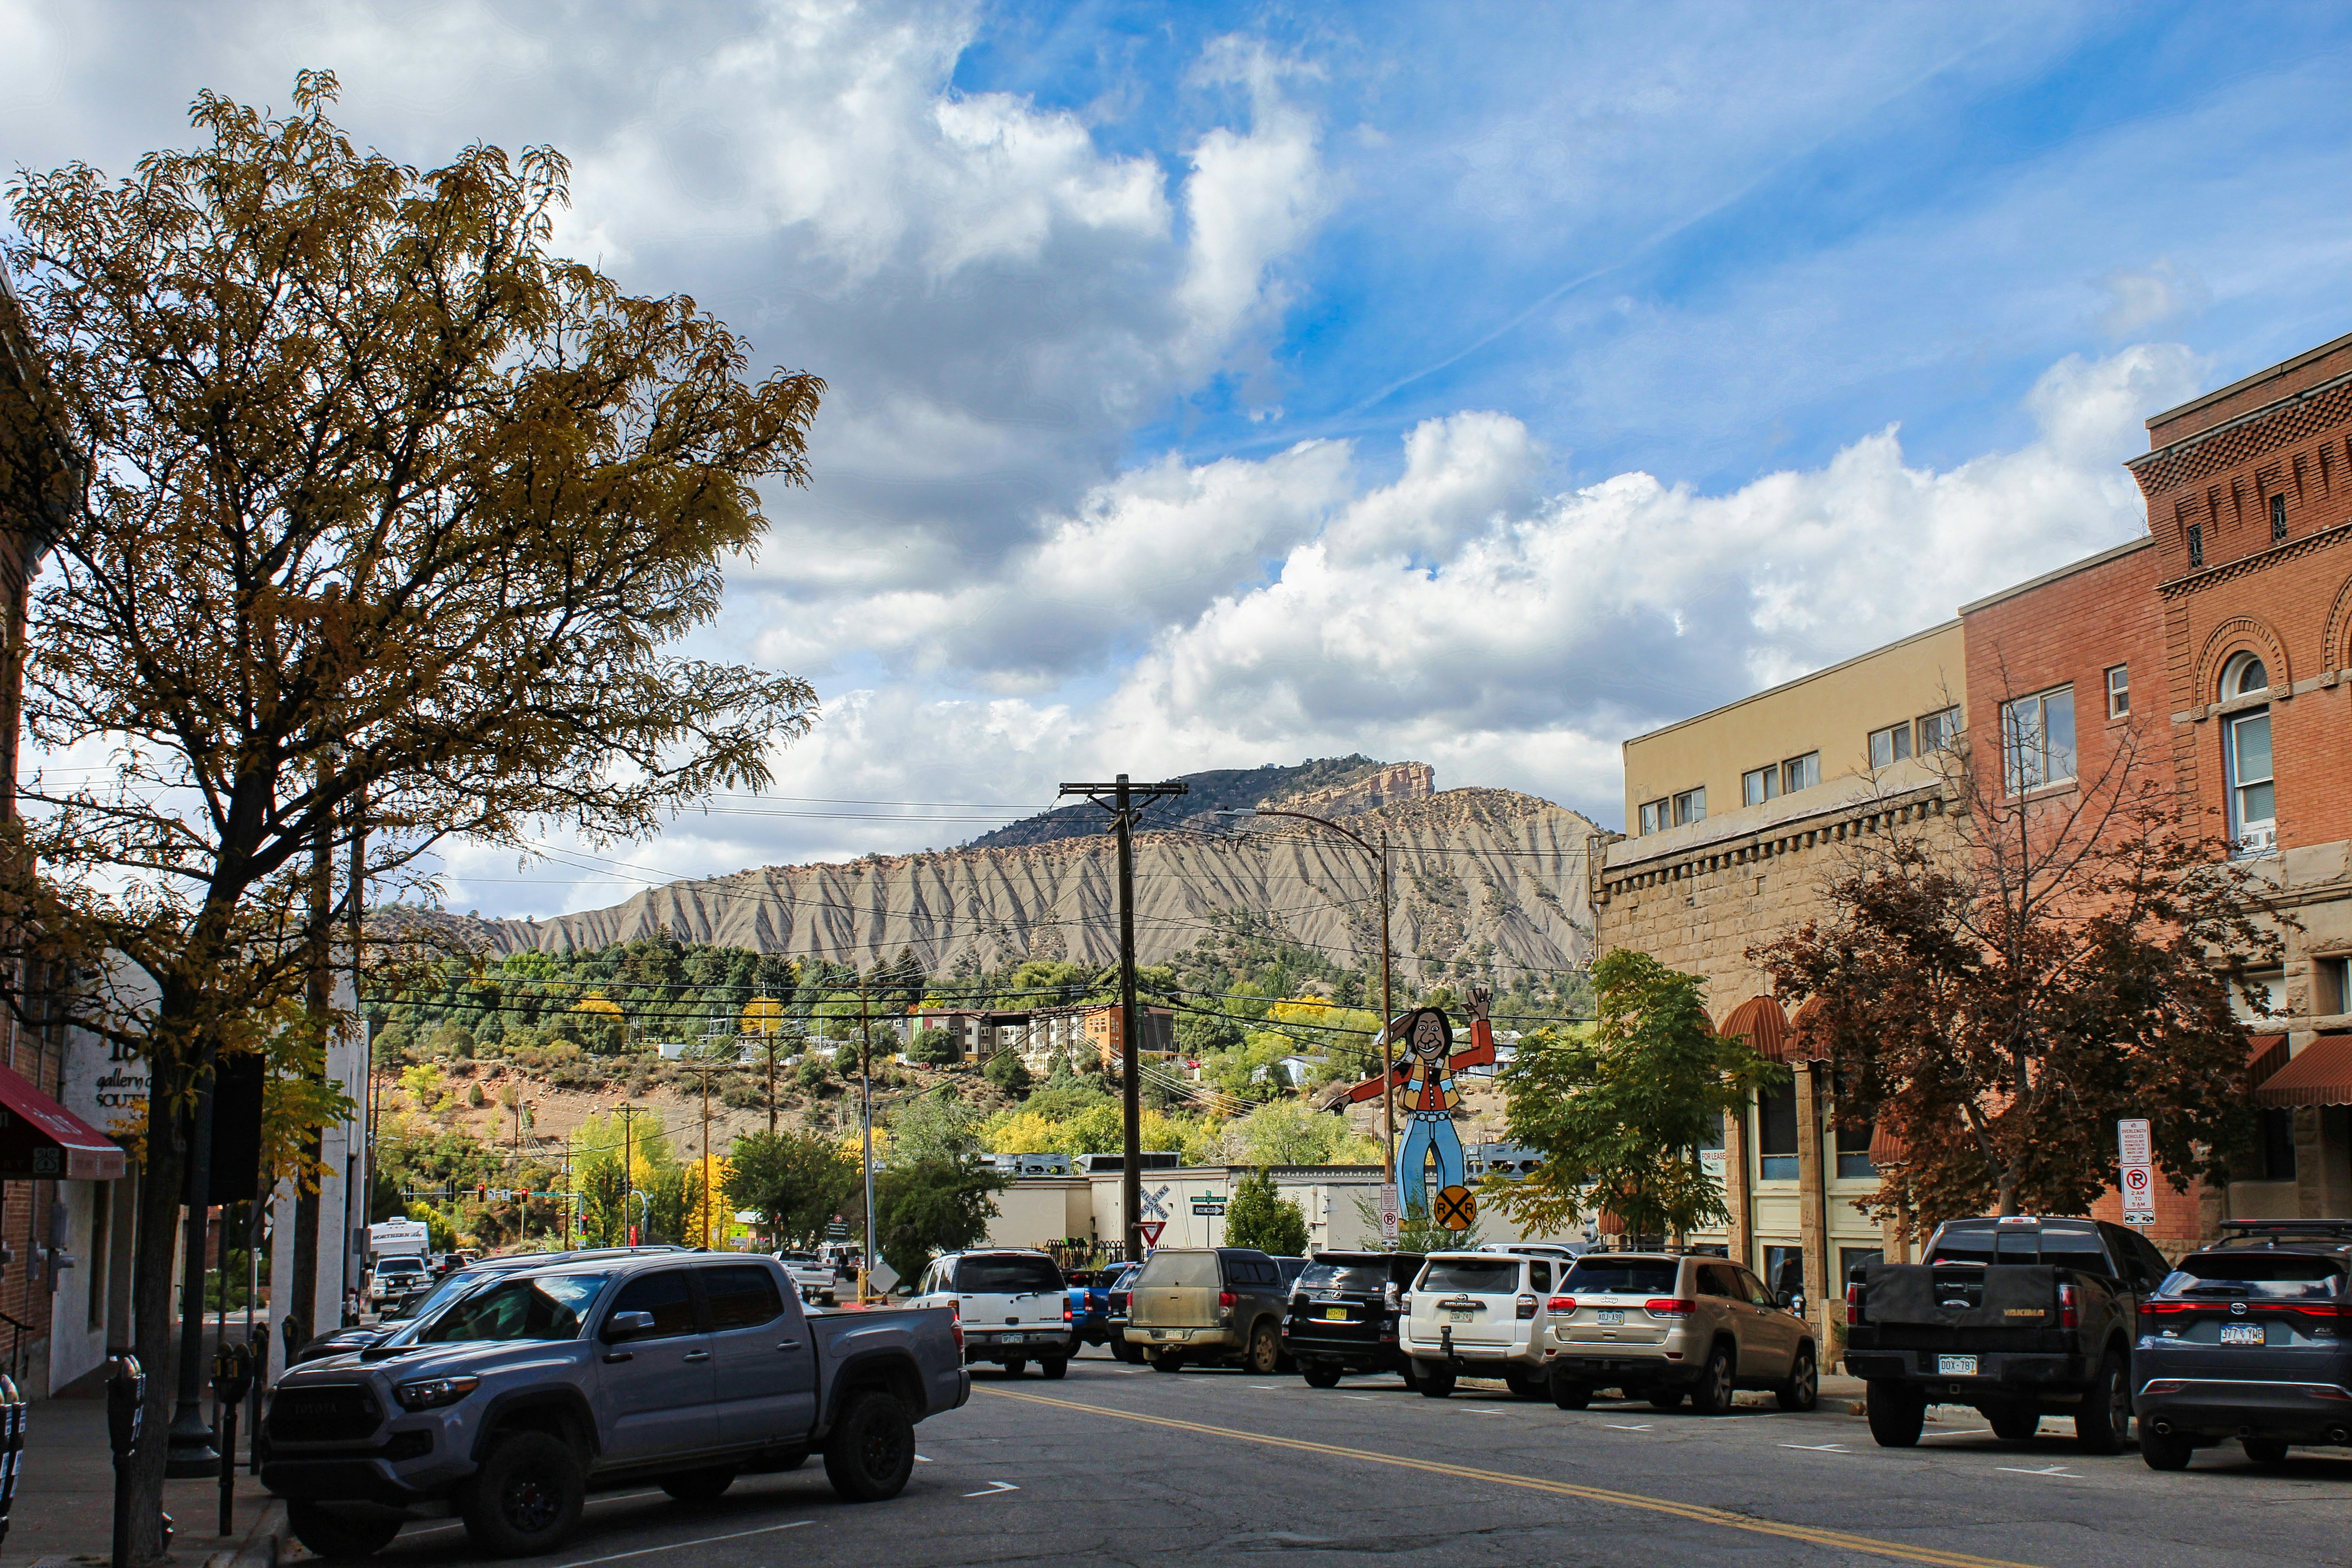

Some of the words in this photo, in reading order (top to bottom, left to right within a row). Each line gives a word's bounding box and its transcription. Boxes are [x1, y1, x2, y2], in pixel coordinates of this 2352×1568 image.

[97, 1068, 144, 1092] gallery
[1141, 1186, 1169, 1215] ROSSING
[1437, 1203, 1446, 1214] R
[1465, 1203, 1474, 1214] R
